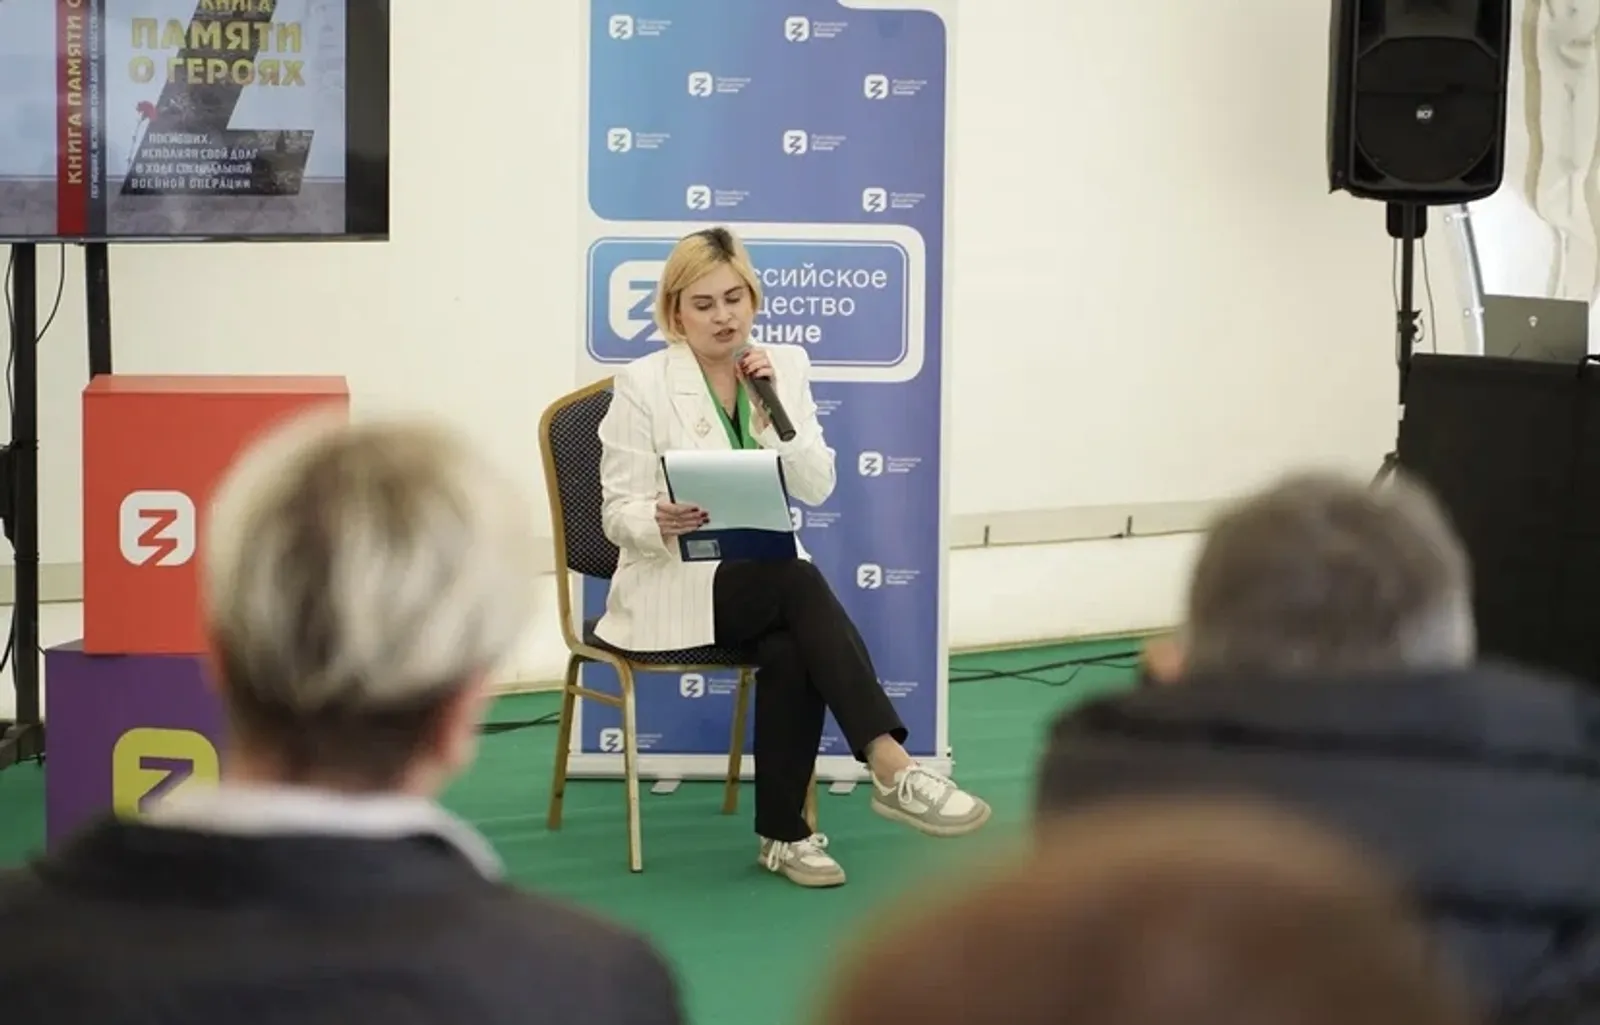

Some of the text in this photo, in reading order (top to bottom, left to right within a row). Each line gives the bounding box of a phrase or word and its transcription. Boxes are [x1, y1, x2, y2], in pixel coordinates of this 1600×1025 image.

[131, 17, 303, 53] ПАМЯТИ
[67, 15, 82, 106] ПАМЯТИ
[128, 56, 306, 87] О ГЕРОЯХ
[67, 113, 82, 184] КНИГА
[131, 177, 251, 190] ВОЕННОЙ ОПЕРАЦИИ
[753, 262, 888, 288] сийское
[751, 323, 822, 344] ание
